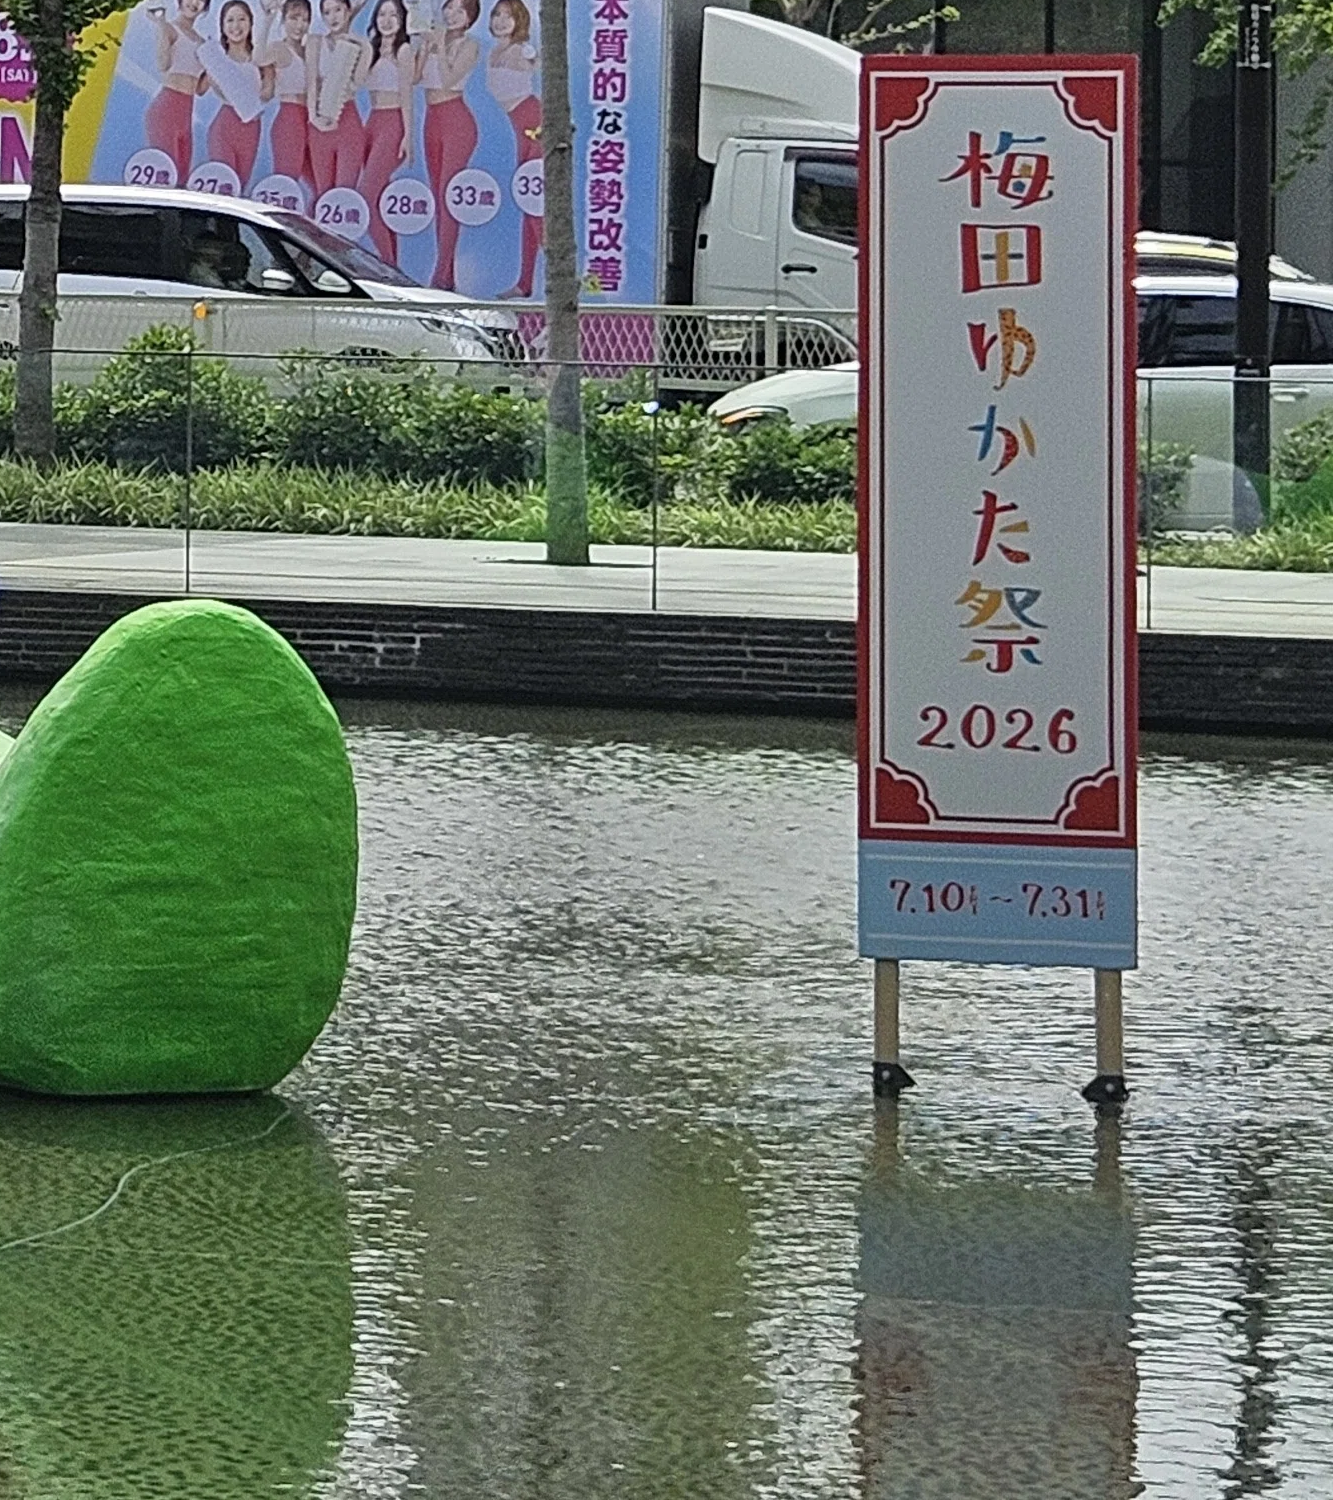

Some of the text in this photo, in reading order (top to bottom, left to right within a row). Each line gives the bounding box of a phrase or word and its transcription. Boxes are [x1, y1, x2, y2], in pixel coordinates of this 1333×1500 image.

[937, 130, 1055, 672] 梅田ゆかた祭
[918, 703, 1079, 756] 2026
